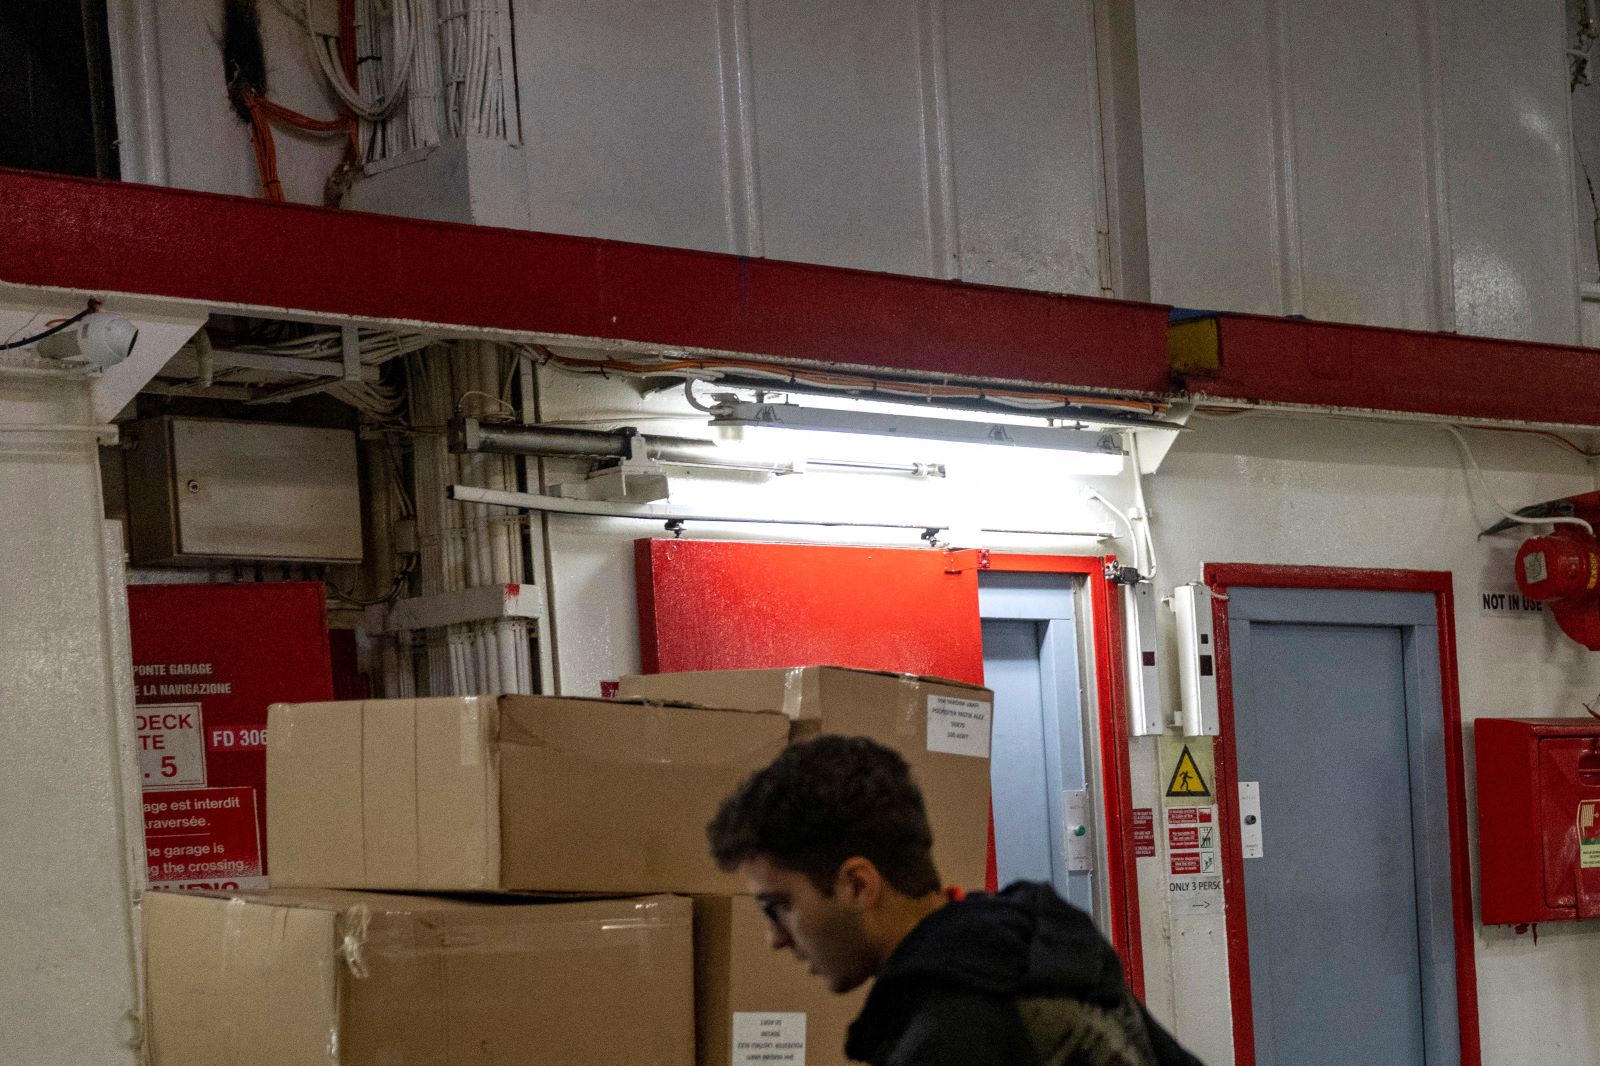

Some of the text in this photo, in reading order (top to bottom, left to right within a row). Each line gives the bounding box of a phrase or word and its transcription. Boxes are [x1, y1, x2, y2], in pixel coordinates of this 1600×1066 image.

[1483, 593, 1543, 612] NOT IN USE
[169, 663, 213, 676] GARAGE
[143, 685, 158, 696] LA
[160, 683, 232, 696] NAVIGAZIONE
[212, 730, 235, 747] FD
[160, 755, 178, 778] 5
[170, 799, 191, 811] est
[194, 796, 241, 809] interdit
[164, 844, 211, 858] garage
[213, 843, 225, 854] is
[163, 863, 185, 874] the
[1169, 882, 1190, 892] ONLY
[1191, 881, 1197, 890] 3
